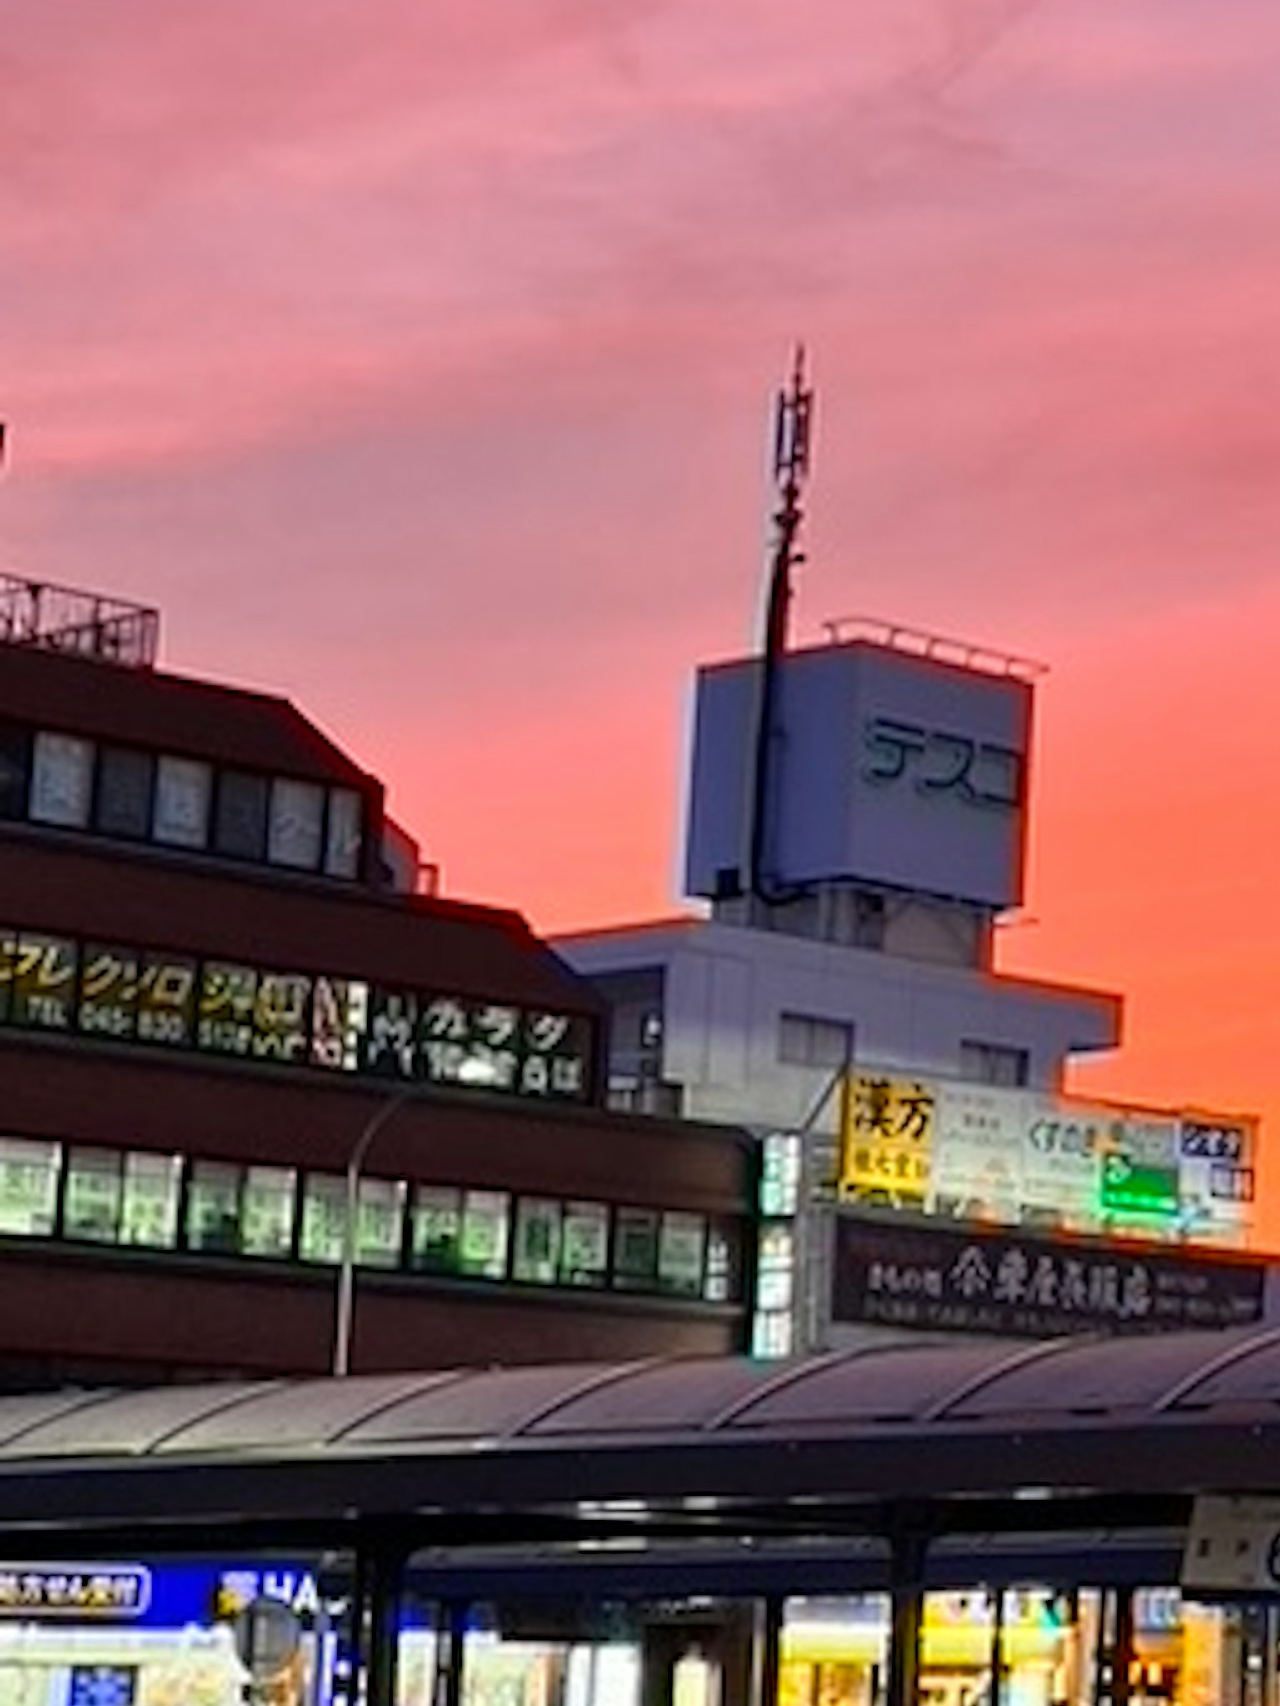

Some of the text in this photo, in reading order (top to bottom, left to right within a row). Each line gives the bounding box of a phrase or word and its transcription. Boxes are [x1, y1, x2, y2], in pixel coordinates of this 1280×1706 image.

[866, 717, 1021, 809] テスコ
[854, 1077, 933, 1143] 漢方
